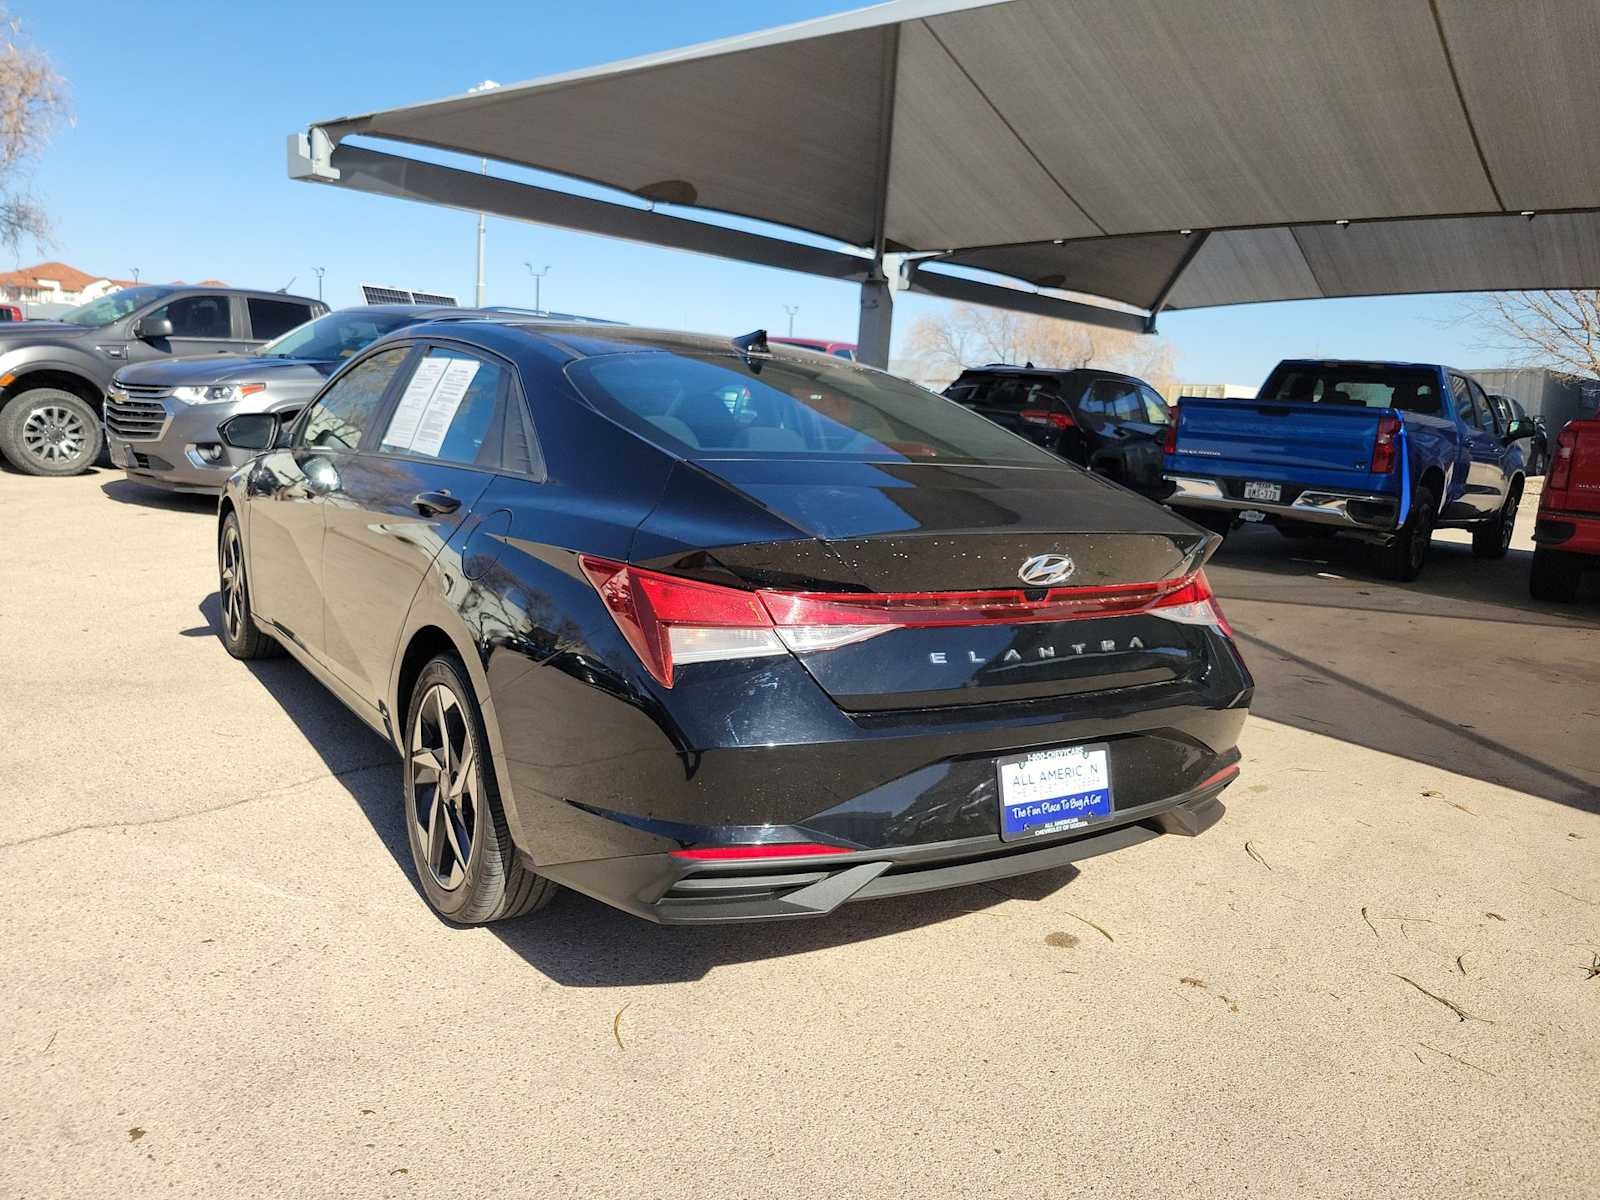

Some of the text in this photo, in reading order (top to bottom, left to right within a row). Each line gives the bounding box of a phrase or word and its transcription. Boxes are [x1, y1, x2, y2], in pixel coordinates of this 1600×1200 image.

[929, 636, 1144, 664] ELANTRA
[1013, 763, 1098, 785] ALL AMERICN
[1012, 807, 1027, 819] The
[1041, 801, 1061, 815] Place
[1060, 798, 1070, 810] To
[1070, 798, 1083, 811] Buy
[1083, 795, 1090, 805] A
